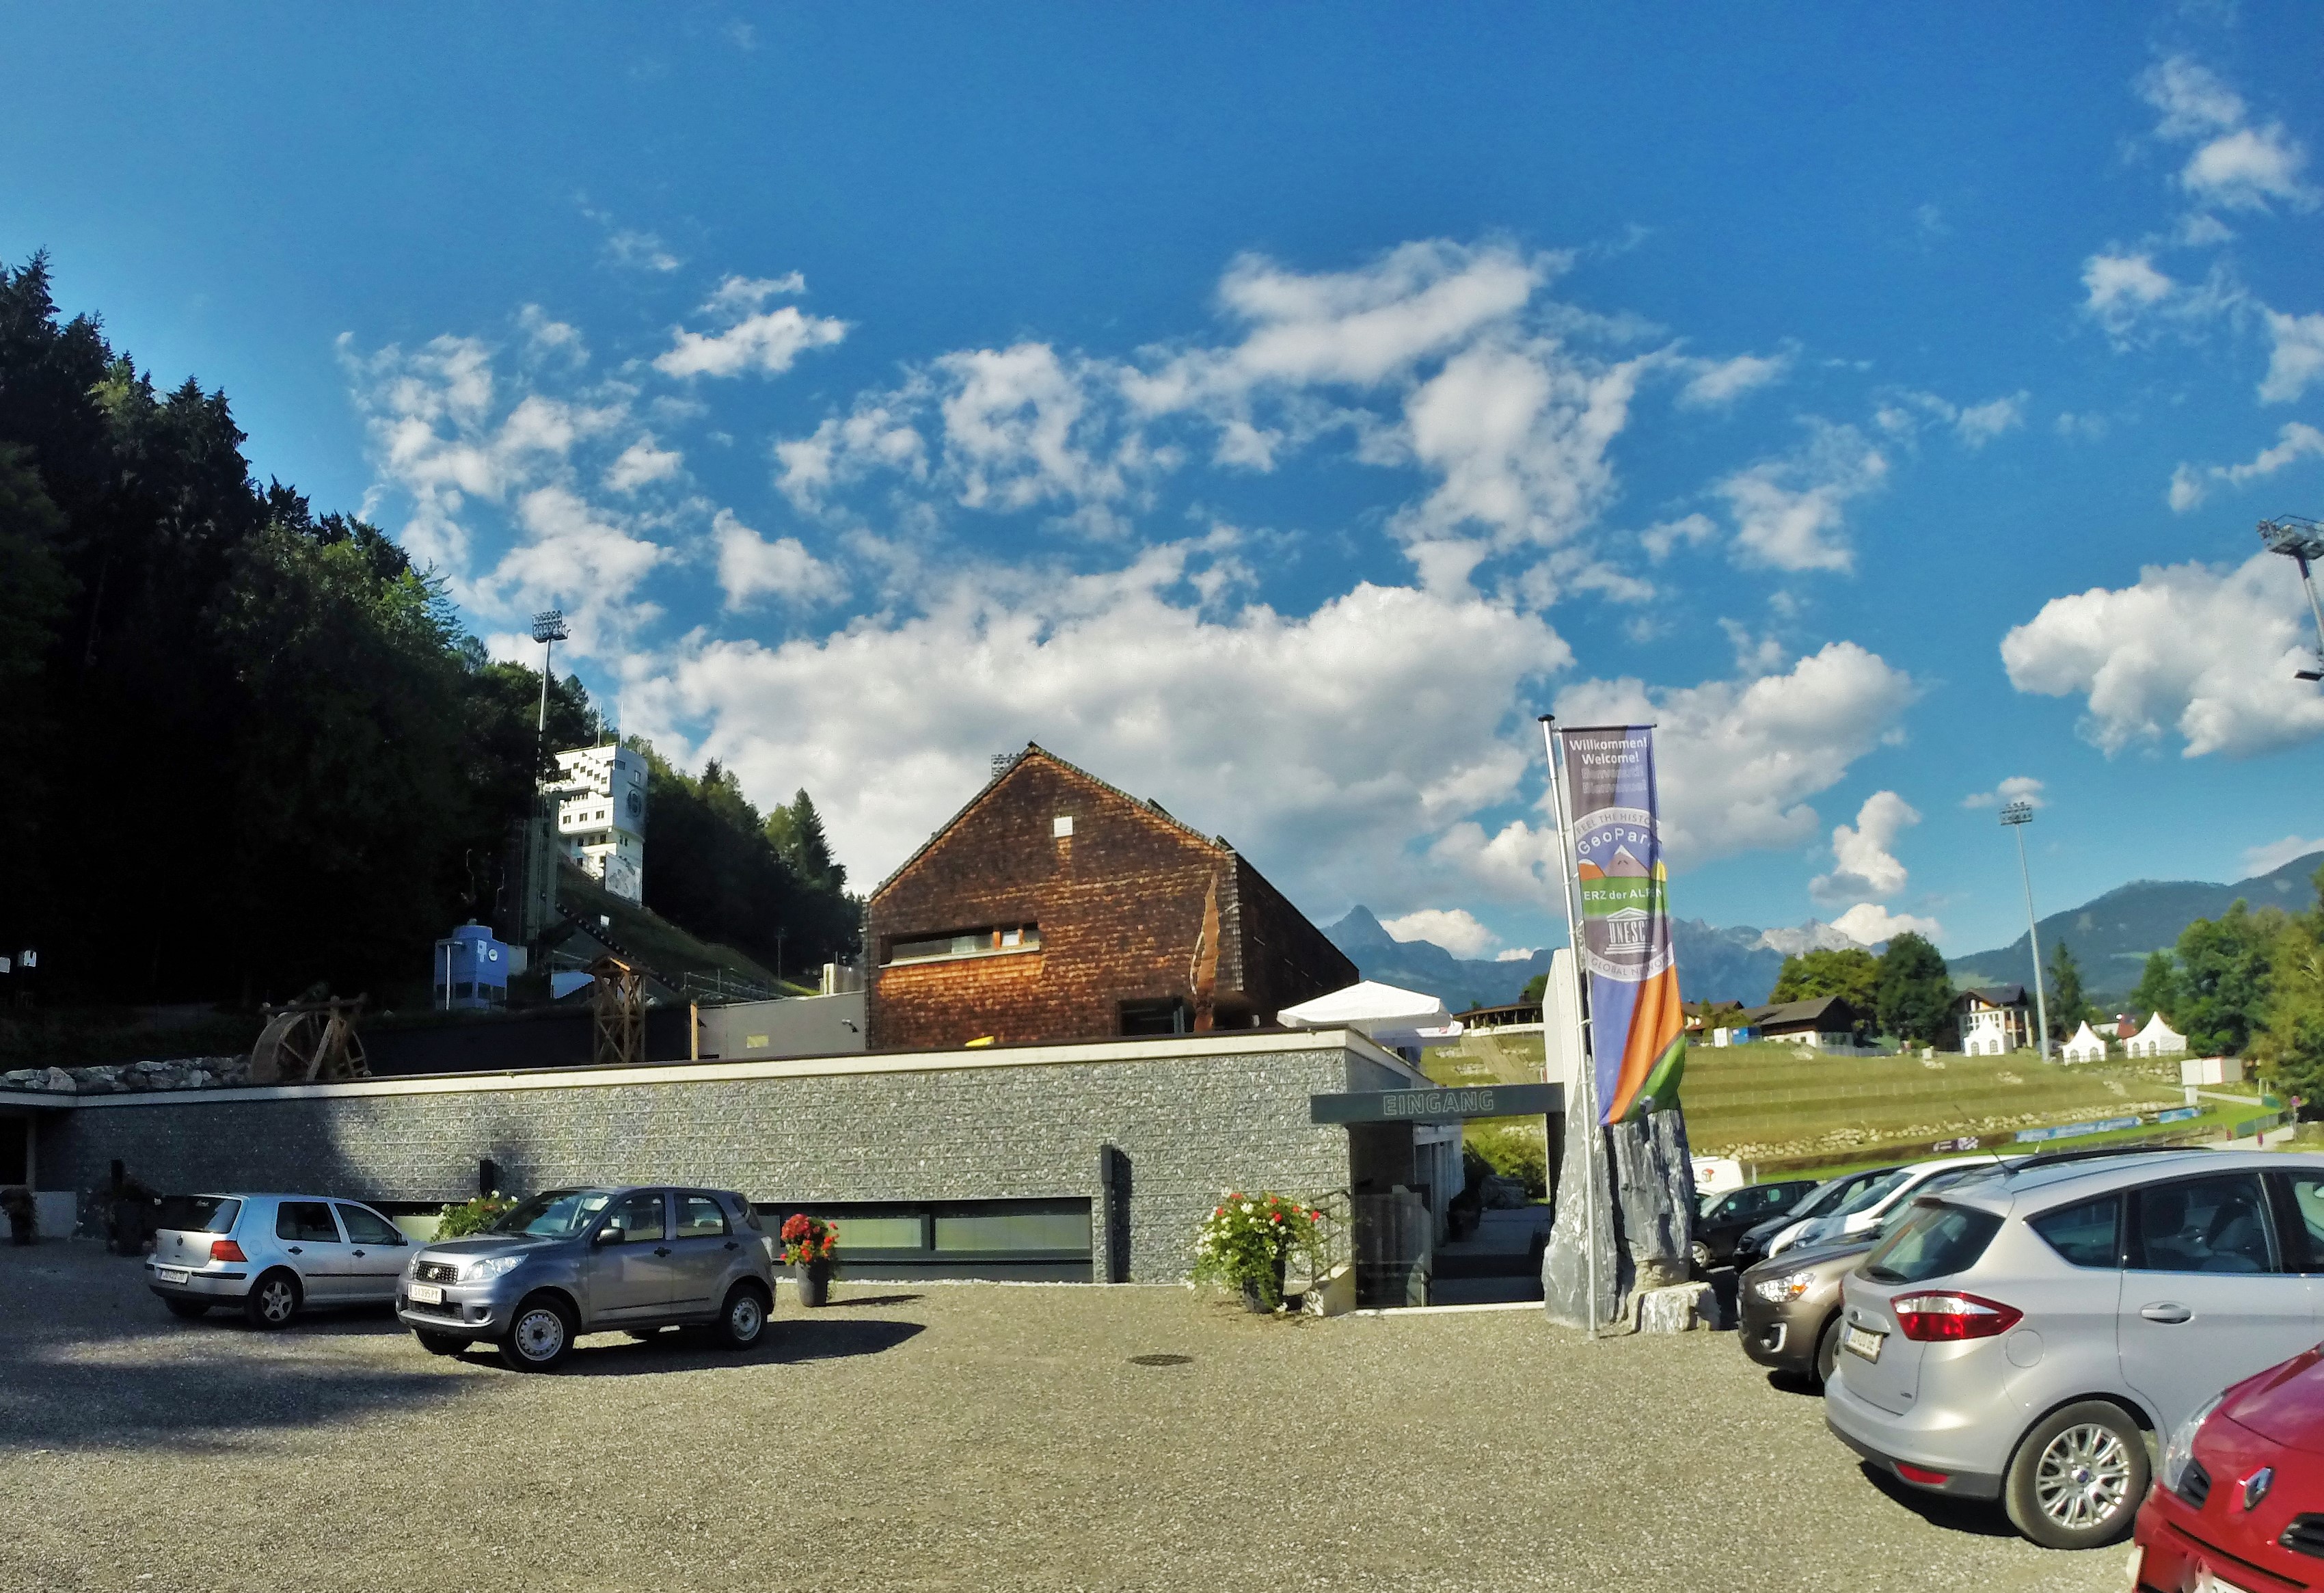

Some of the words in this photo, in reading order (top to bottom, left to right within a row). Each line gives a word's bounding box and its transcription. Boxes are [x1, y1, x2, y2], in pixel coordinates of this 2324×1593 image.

[1569, 737, 1647, 751] Willkommen!
[1581, 751, 1639, 765] Welcome!
[1620, 813, 1650, 825] HISTO
[1578, 827, 1650, 855] GeoPar
[1584, 890, 1607, 900] ERZ
[1609, 890, 1627, 900] der
[1629, 887, 1662, 898] ALPN
[1608, 920, 1649, 943] UNESC
[1591, 957, 1628, 976] GLOBAL
[1383, 1090, 1494, 1116] EINGANG
